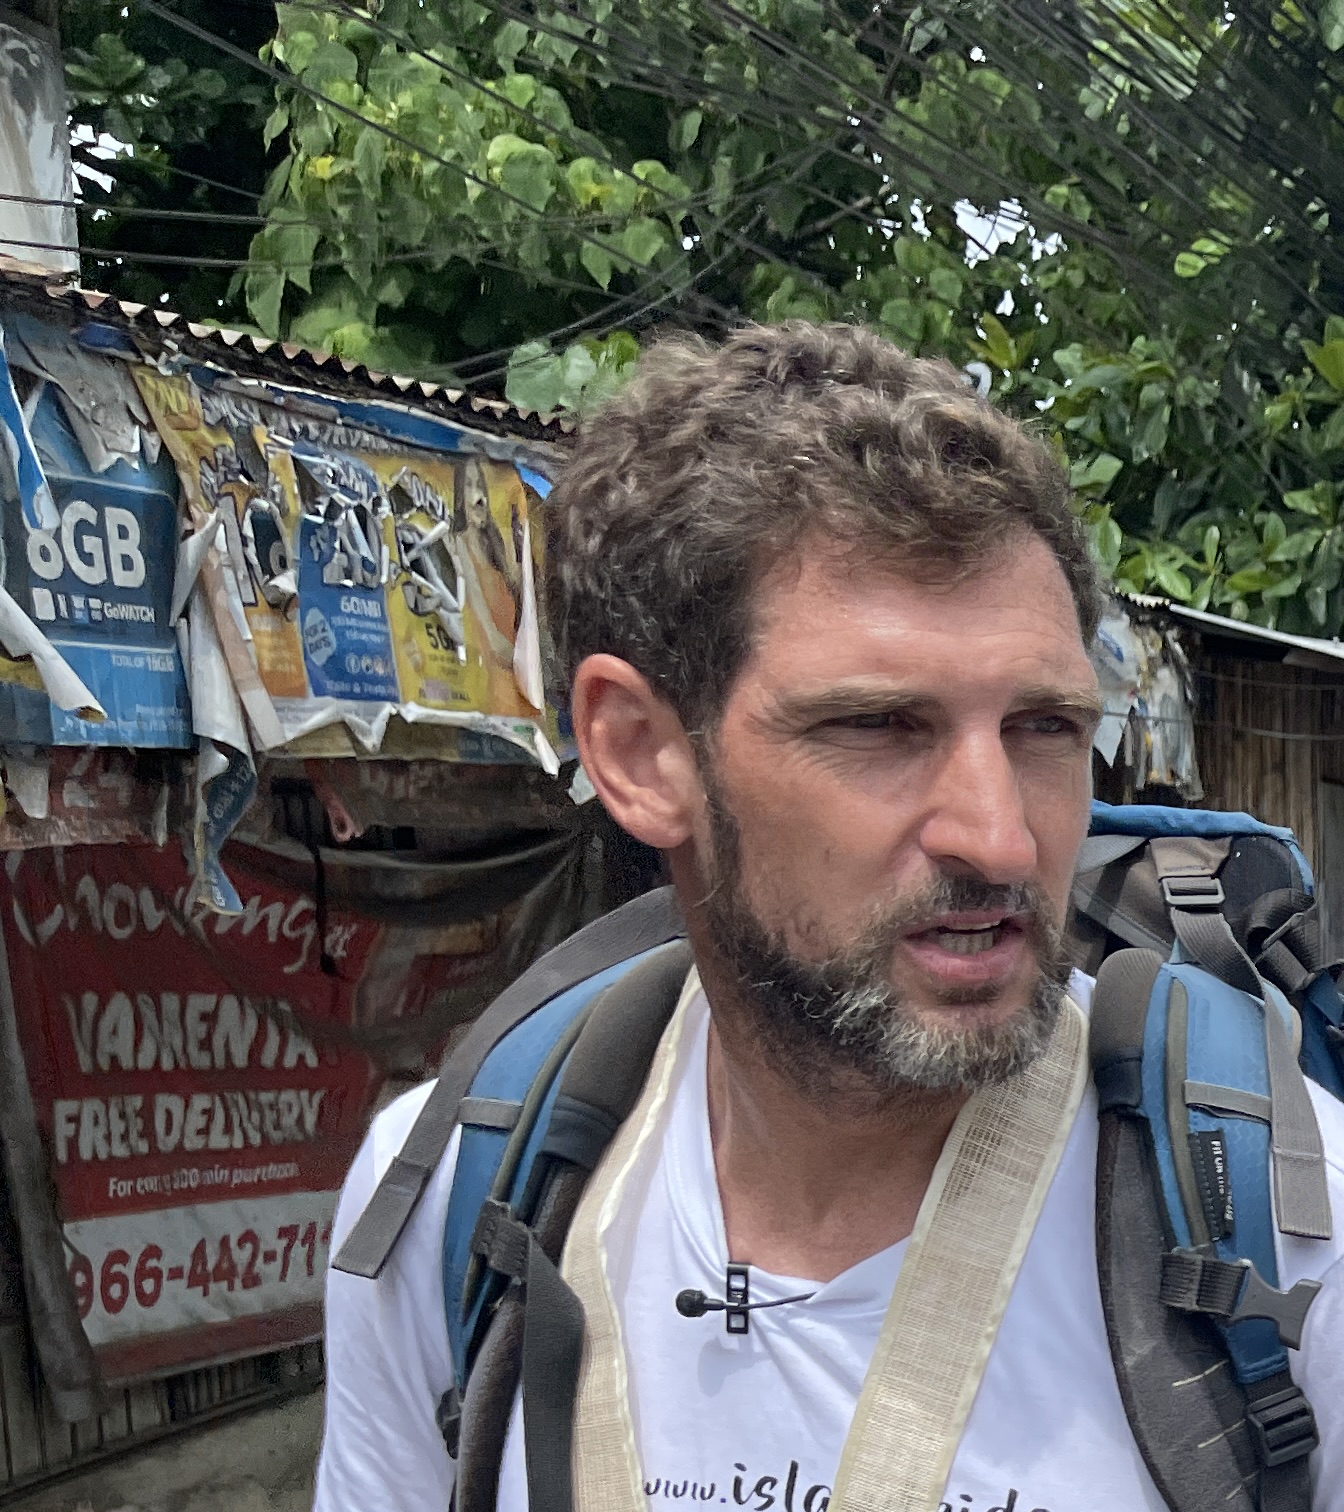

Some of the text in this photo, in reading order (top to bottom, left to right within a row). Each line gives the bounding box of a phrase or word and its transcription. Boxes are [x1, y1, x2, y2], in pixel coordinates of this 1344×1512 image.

[27, 501, 145, 588] 8GB
[53, 1088, 326, 1164] FREE DELIVERY
[108, 1176, 133, 1198] For
